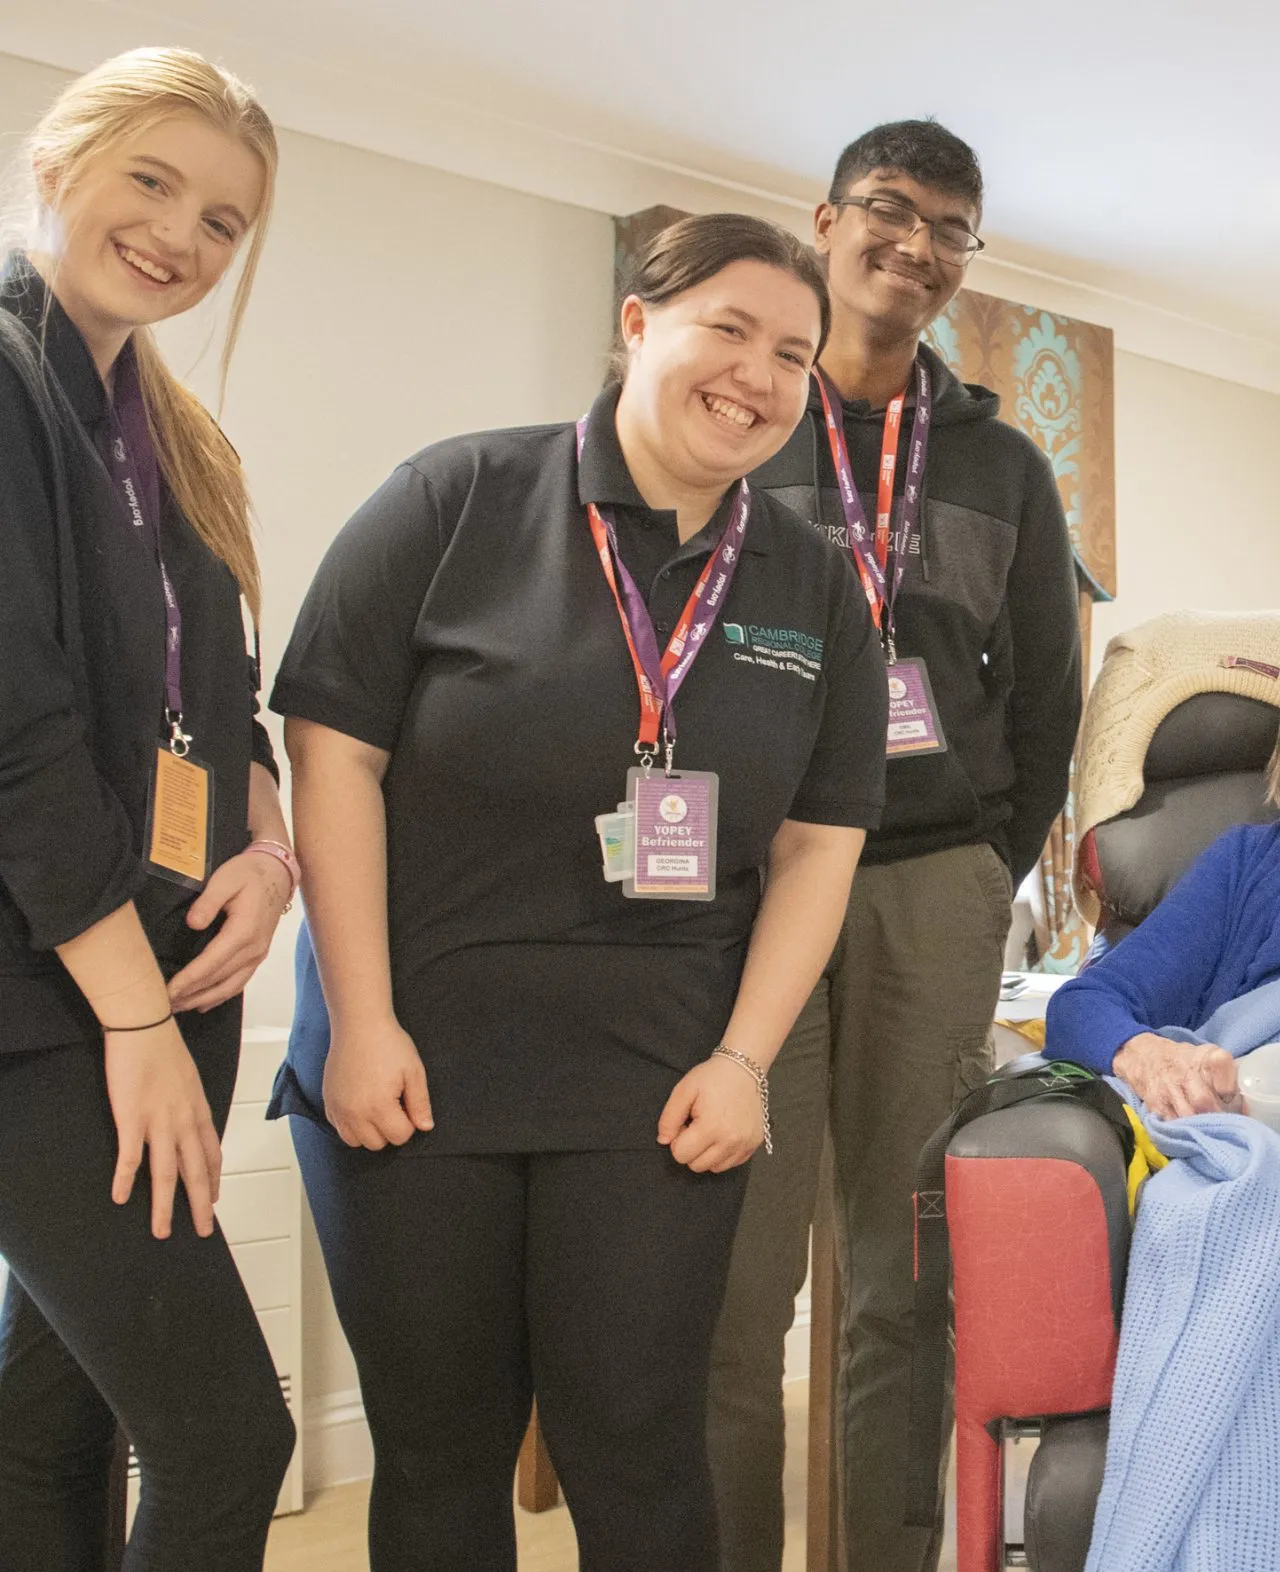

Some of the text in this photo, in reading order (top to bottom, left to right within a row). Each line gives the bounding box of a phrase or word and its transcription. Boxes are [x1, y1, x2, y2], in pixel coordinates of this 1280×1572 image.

[122, 477, 144, 527] yopey.org
[706, 572, 727, 607] yopey.org
[748, 625, 823, 652] CAMBRIDGE
[733, 652, 755, 664] Care,
[755, 655, 779, 669] Health
[779, 661, 786, 670] &
[889, 700, 914, 709] OPEY
[889, 707, 926, 717] friender
[654, 825, 693, 836] YOPEY
[642, 836, 705, 848] Befriender
